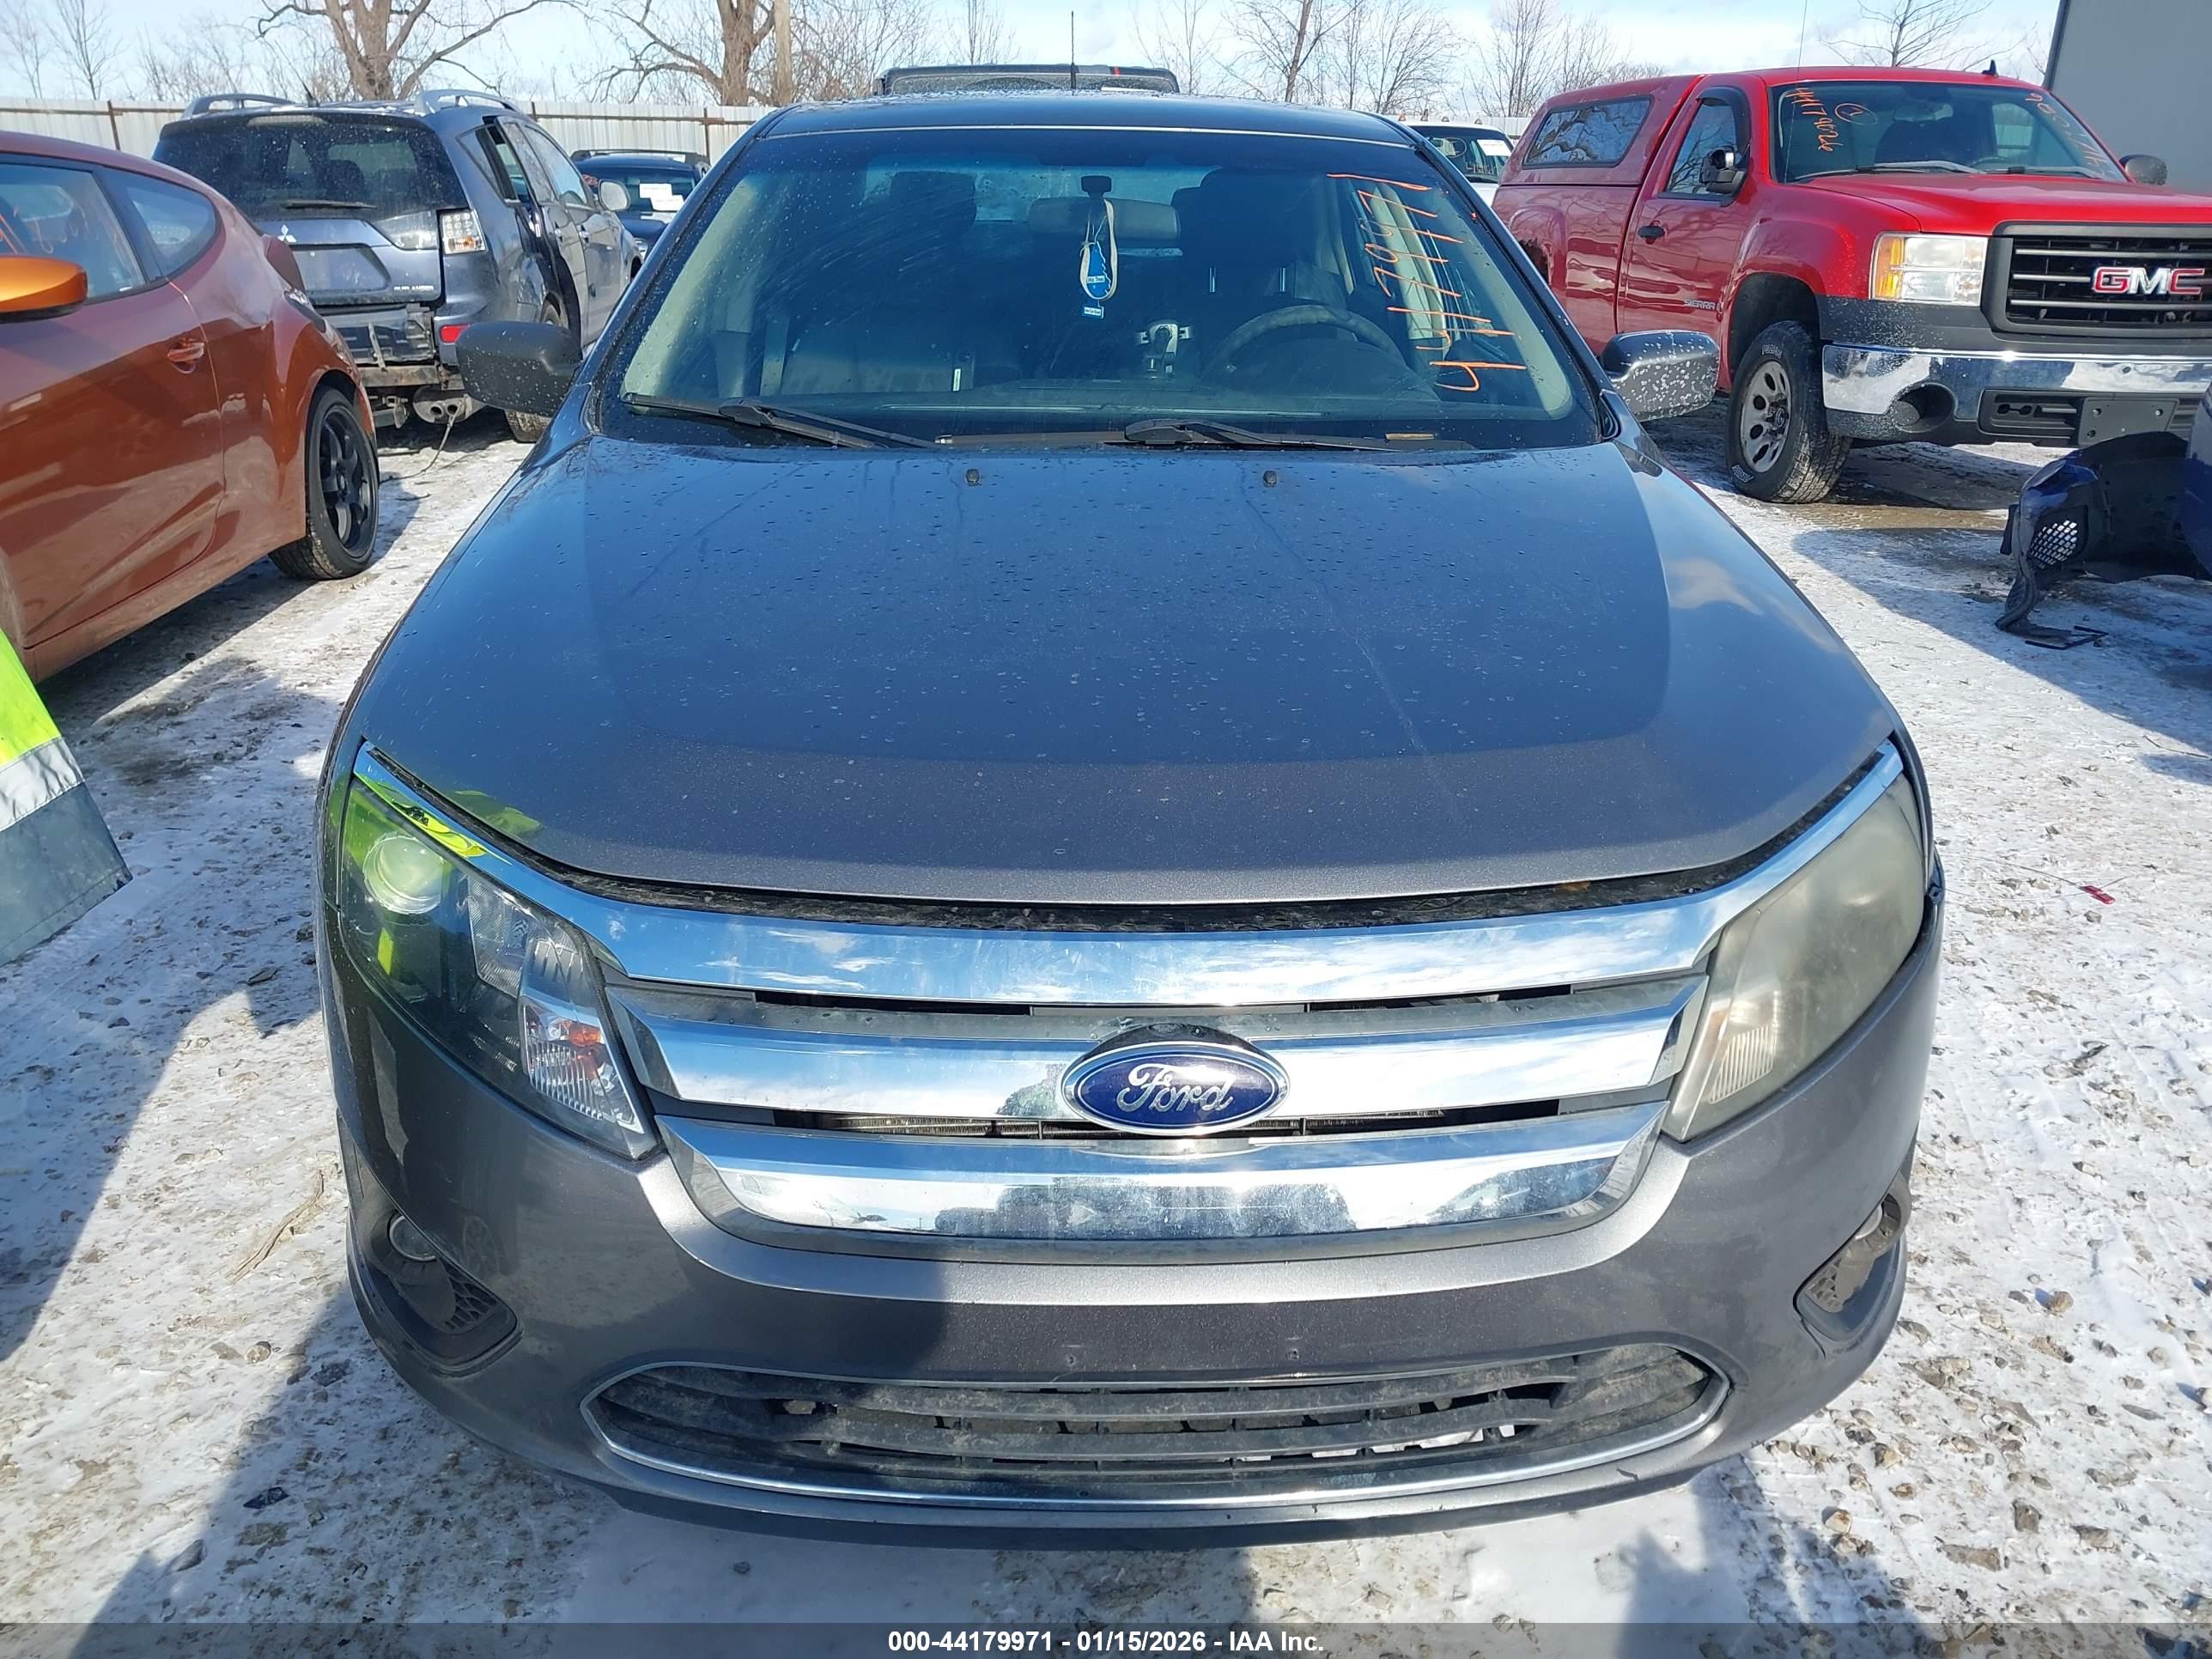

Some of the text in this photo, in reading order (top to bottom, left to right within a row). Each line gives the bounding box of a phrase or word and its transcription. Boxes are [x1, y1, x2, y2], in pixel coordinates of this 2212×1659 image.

[1326, 173, 1527, 392] 44179971
[2094, 267, 2206, 295] GMC
[1684, 298, 1716, 310] SIERRA
[1116, 1063, 1237, 1113] Ford
